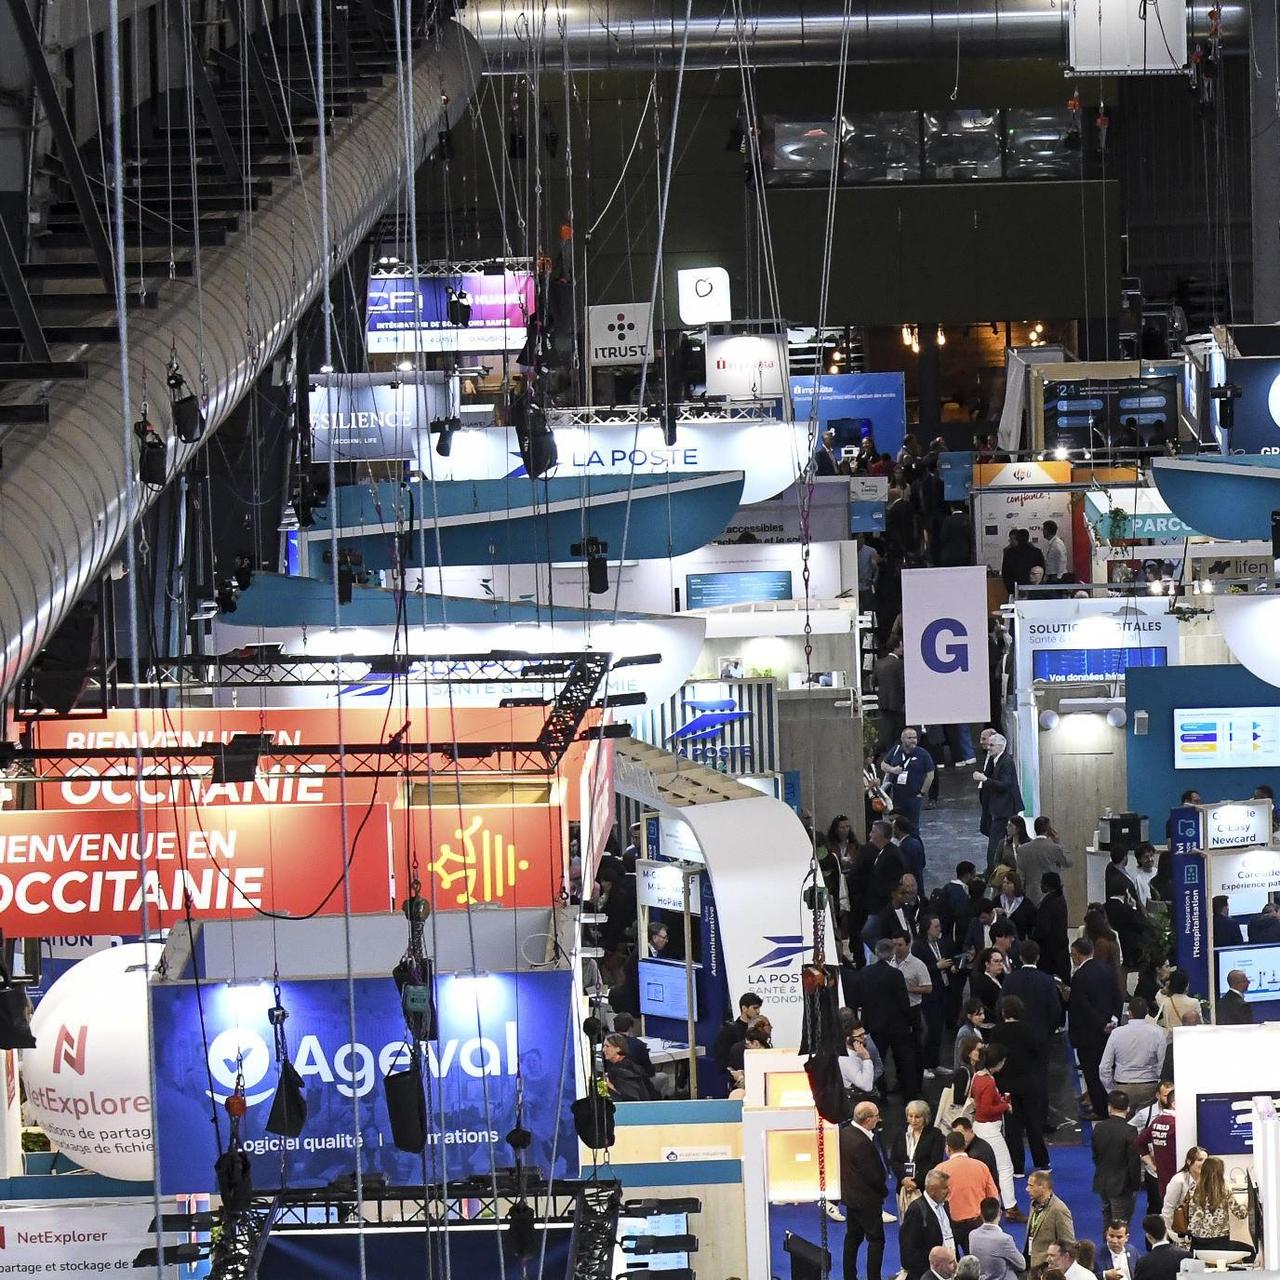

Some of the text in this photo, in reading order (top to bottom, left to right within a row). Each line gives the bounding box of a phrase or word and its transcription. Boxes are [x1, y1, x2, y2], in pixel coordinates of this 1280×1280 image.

[594, 345, 647, 360] ITRUST
[572, 448, 698, 467] LA POSTE
[1236, 558, 1270, 574] lifen
[920, 618, 969, 674] G
[188, 829, 237, 861] EN
[1212, 833, 1257, 846] Newcard
[708, 906, 718, 977] Administrative
[748, 973, 767, 985] LA
[293, 1021, 525, 1099] Ageval
[303, 1130, 364, 1153] qualité
[17, 1230, 108, 1246] NetExplorer
[45, 1259, 129, 1274] et stockage de
